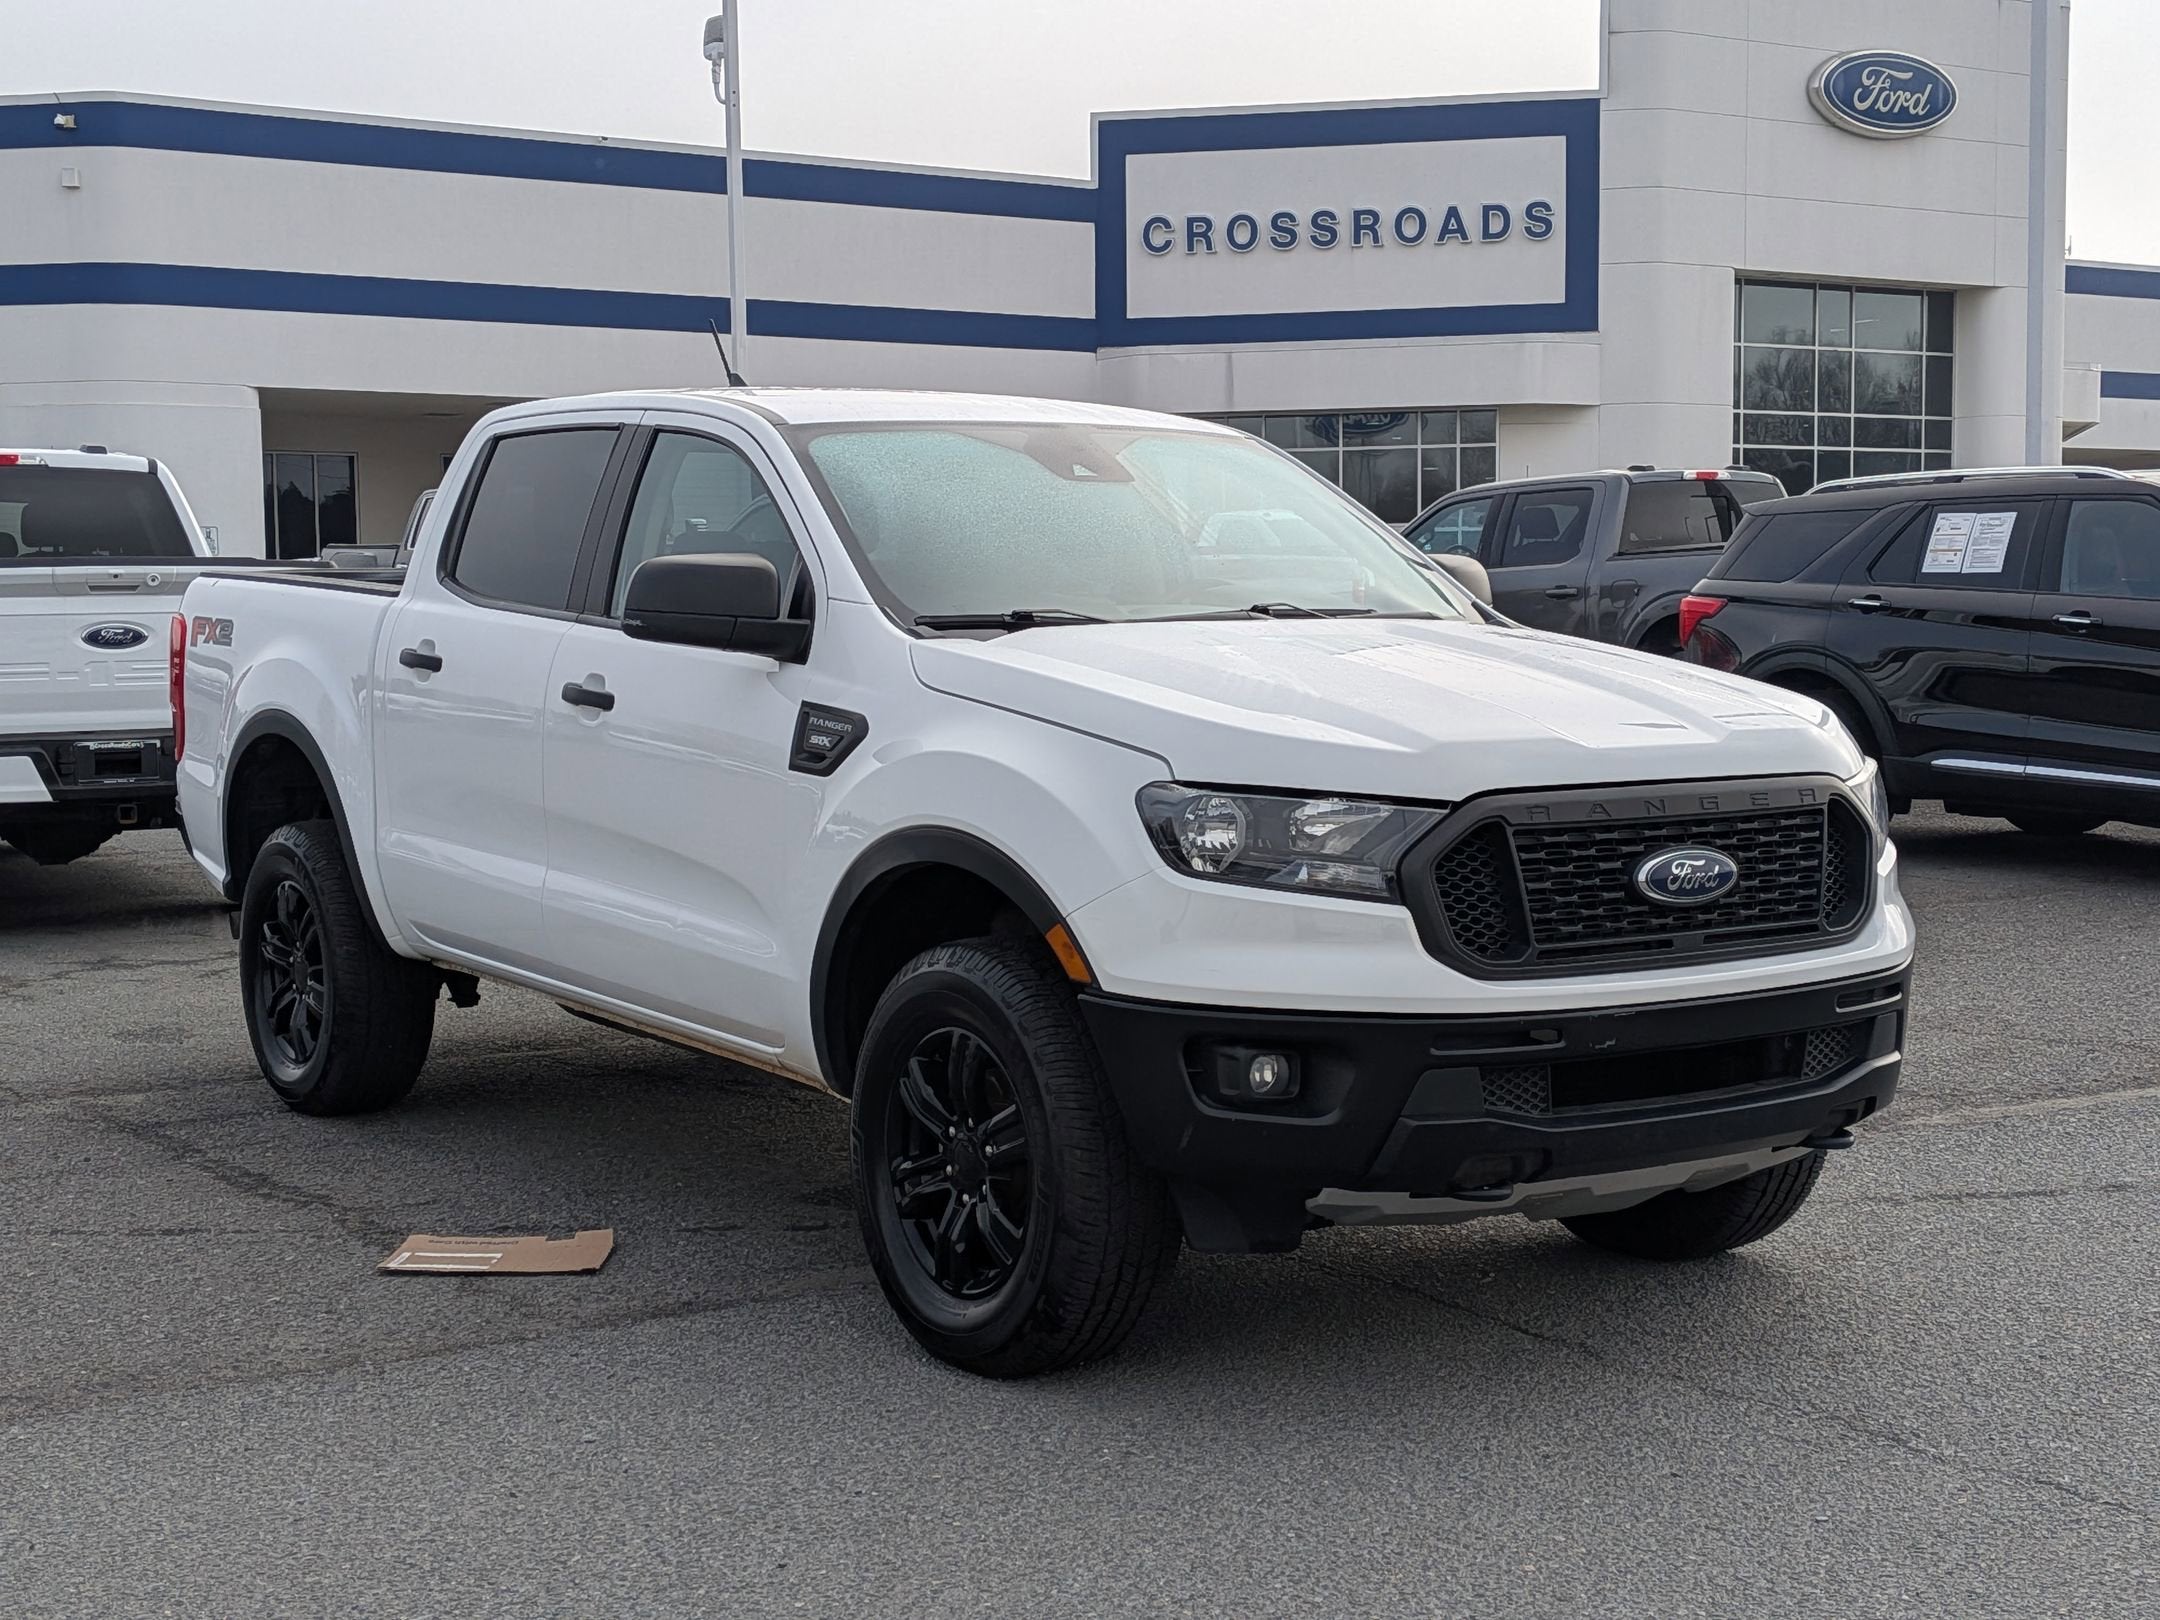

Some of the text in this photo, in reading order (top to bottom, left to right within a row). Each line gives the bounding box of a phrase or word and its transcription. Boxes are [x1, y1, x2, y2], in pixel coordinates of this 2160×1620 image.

[1853, 66, 1933, 116] Ford
[1141, 200, 1556, 256] CROSSROADS
[97, 628, 134, 644] Ford
[190, 615, 234, 647] FX2
[809, 717, 852, 732] RANGER
[809, 735, 832, 747] STX
[1525, 787, 1817, 823] RANGER
[1667, 859, 1720, 891] Ford
